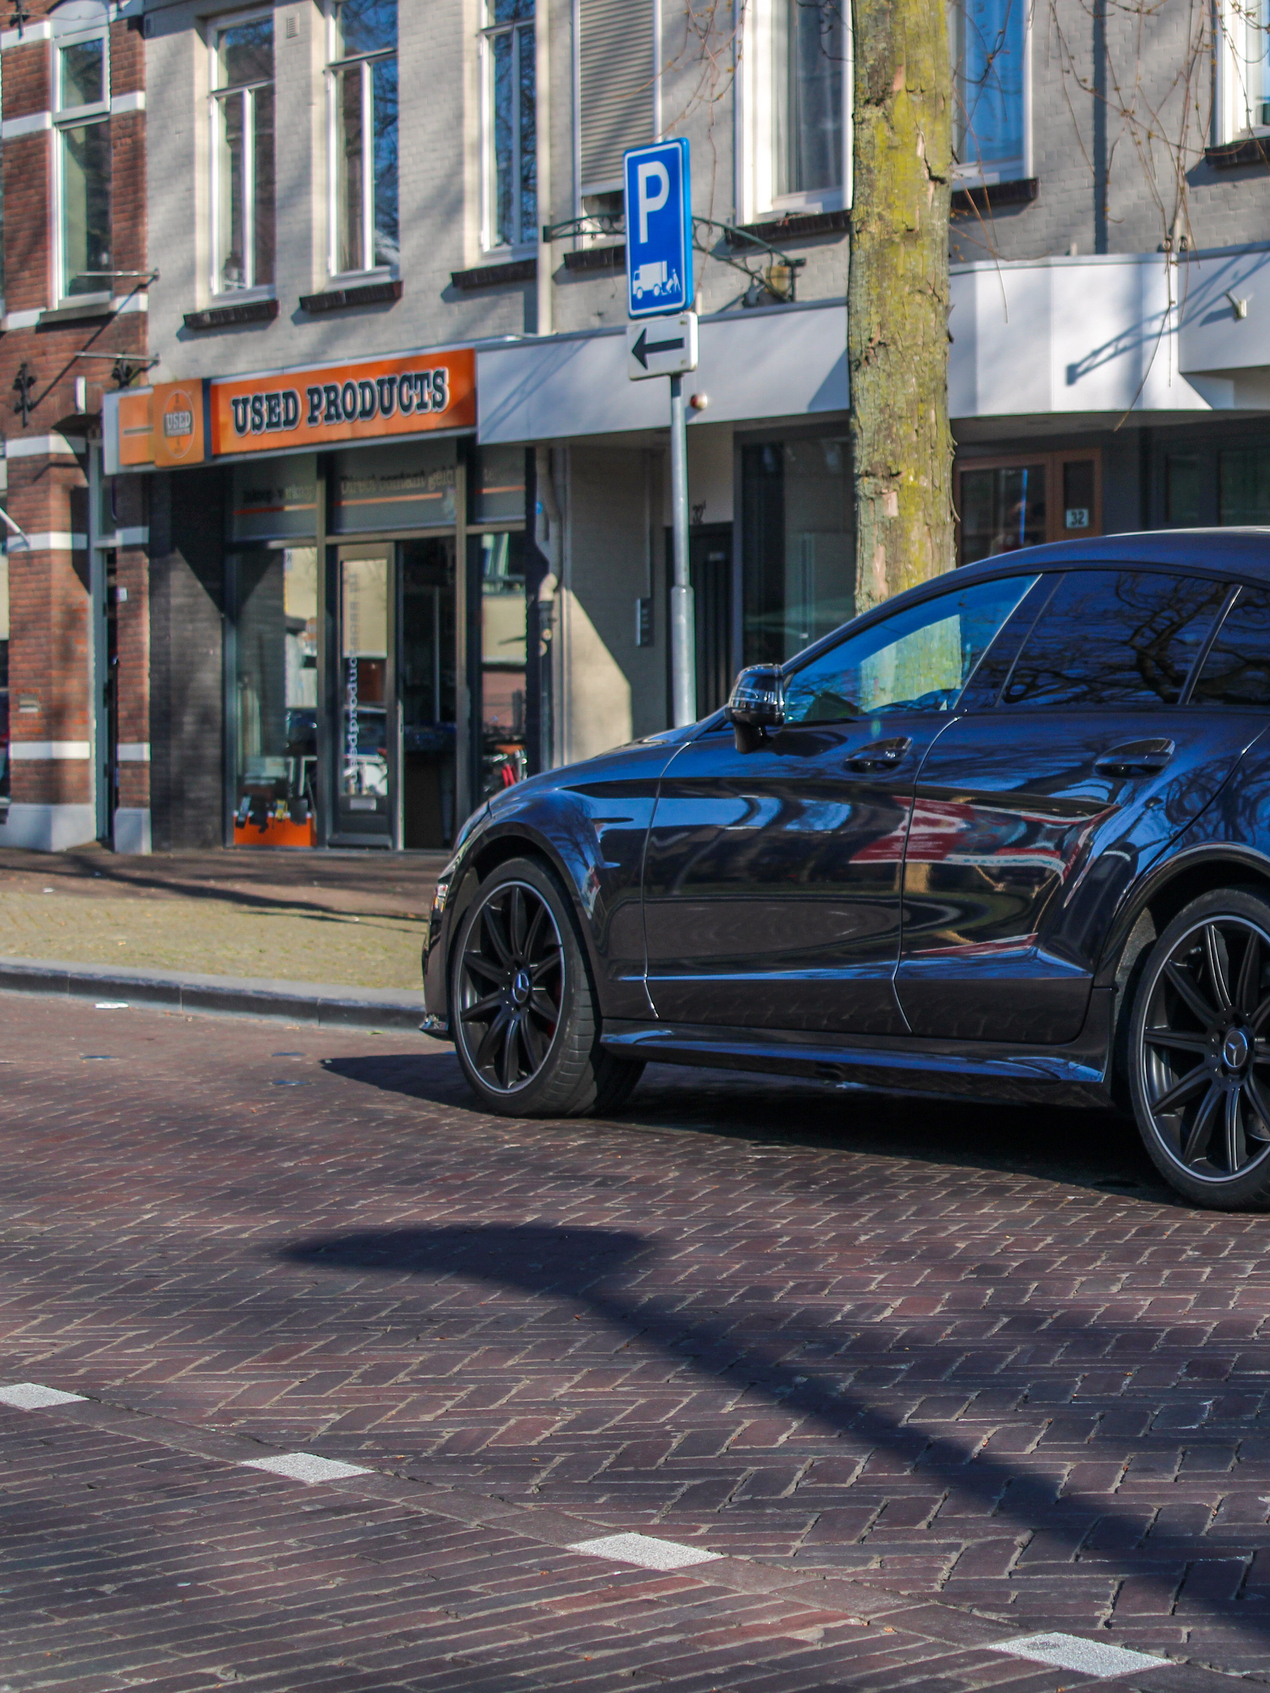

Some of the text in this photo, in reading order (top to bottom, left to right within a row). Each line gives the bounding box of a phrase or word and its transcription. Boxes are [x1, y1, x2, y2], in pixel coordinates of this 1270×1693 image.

[638, 161, 670, 244] P
[166, 411, 191, 429] USED
[231, 368, 448, 436] USED PRODUCTS
[1070, 510, 1085, 526] 32
